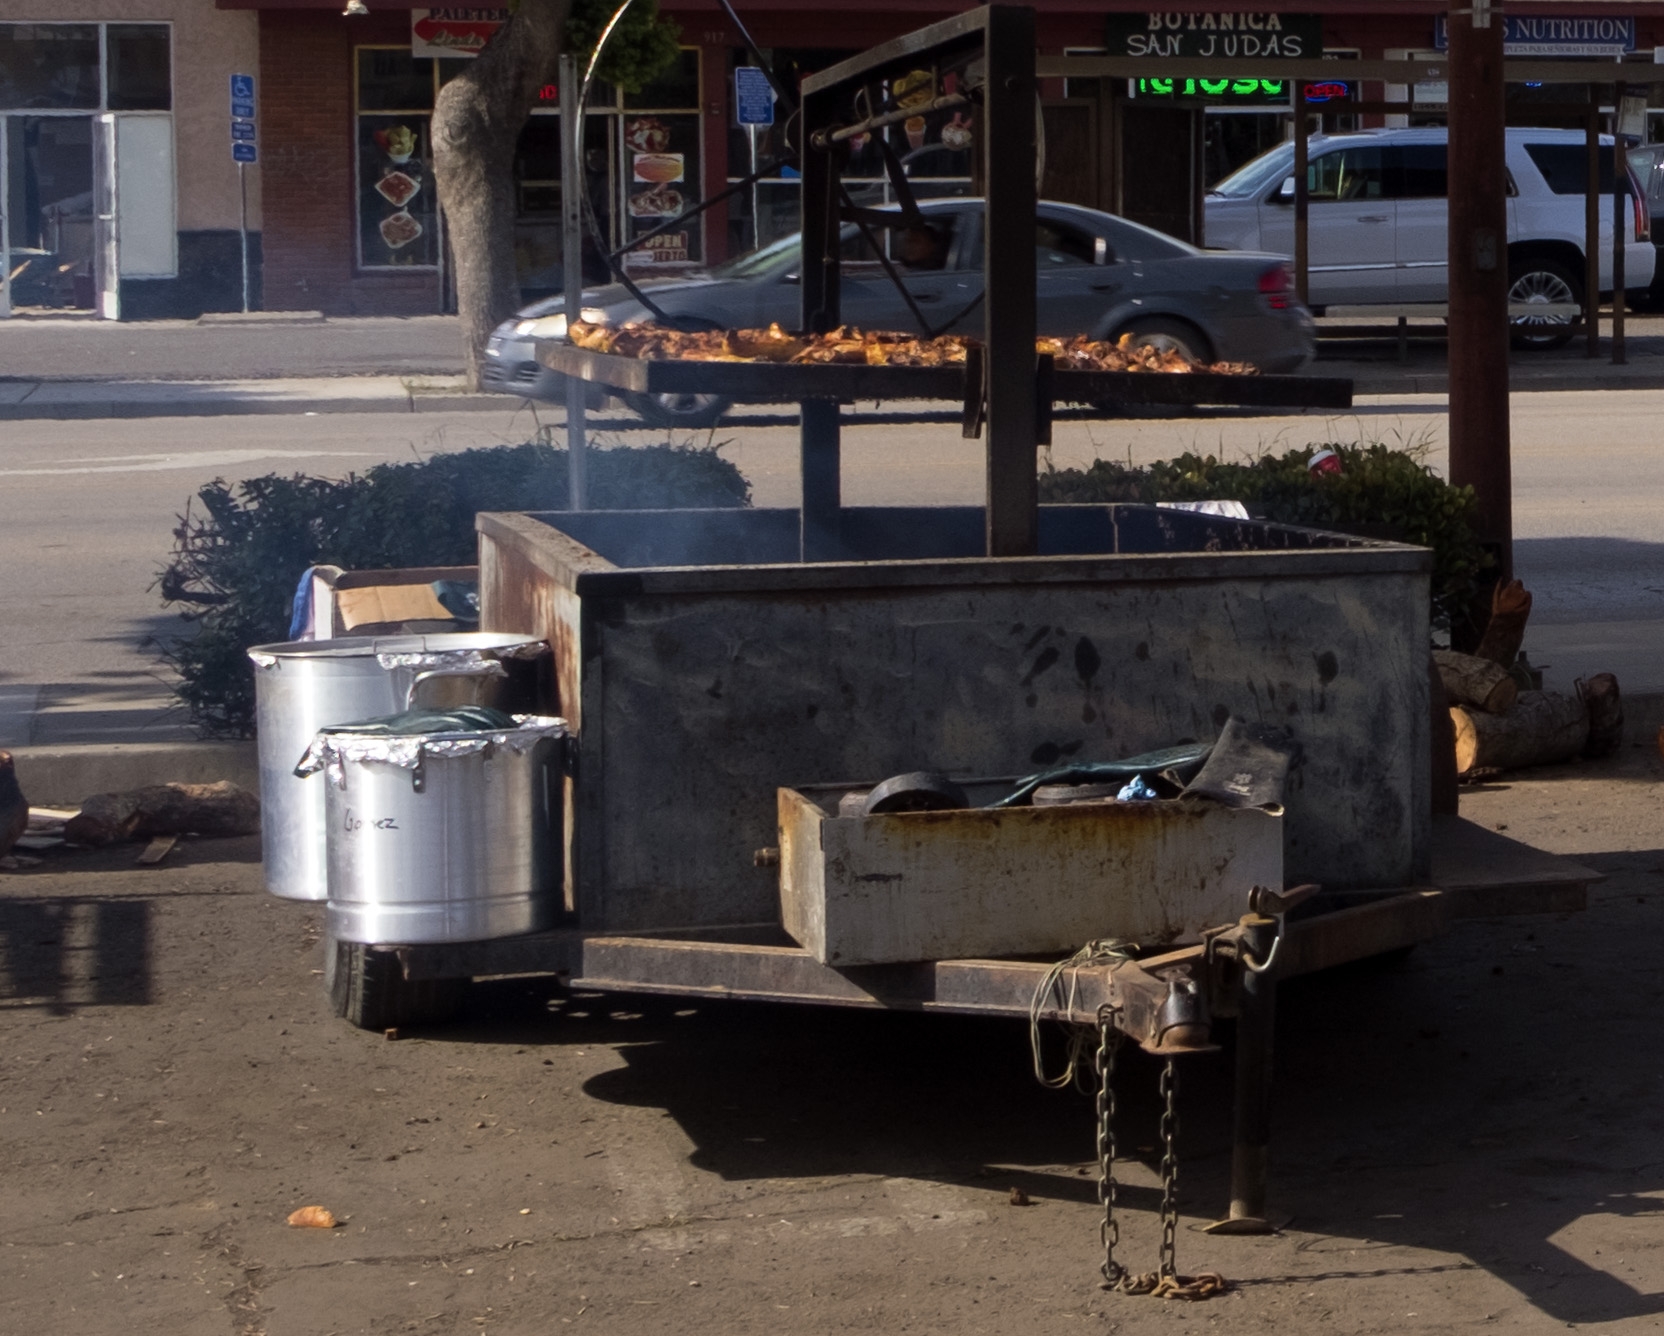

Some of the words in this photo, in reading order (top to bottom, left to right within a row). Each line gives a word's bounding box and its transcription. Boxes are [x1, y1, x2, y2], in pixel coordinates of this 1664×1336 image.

[430, 8, 509, 21] PALETER
[1147, 13, 1283, 31] BOTANICA
[1515, 18, 1630, 40] NUTRITION
[1127, 34, 1184, 57] SAN
[1199, 34, 1303, 57] JUDAS
[1304, 84, 1345, 98] OPEN
[344, 808, 399, 832] Goez
